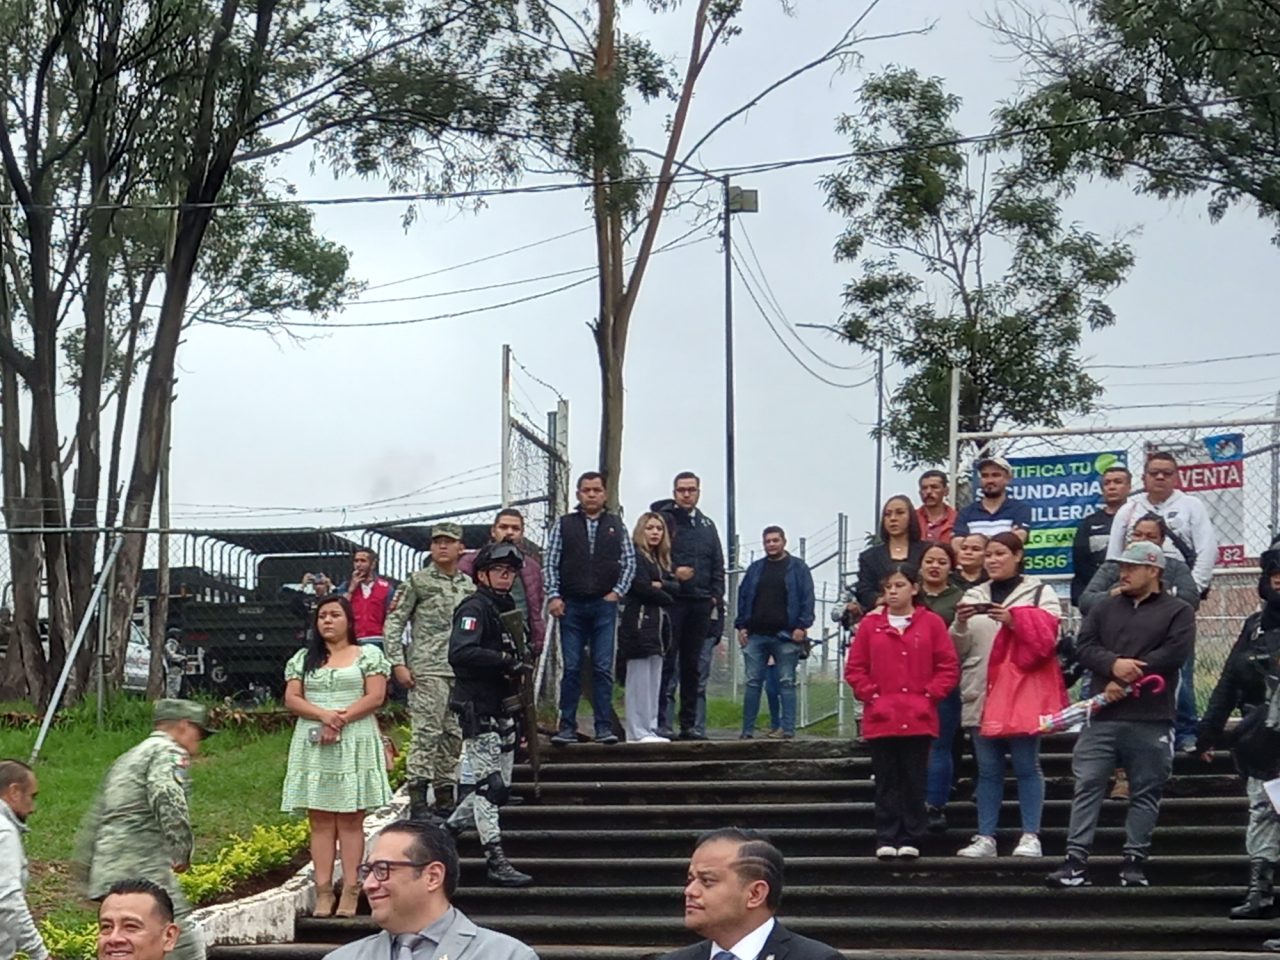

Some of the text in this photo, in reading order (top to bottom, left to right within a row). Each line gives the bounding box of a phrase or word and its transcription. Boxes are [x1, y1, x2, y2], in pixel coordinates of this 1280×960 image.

[1011, 461, 1092, 478] TIFICA TU
[1178, 464, 1241, 488] VENTA
[1023, 554, 1068, 570] 3586
